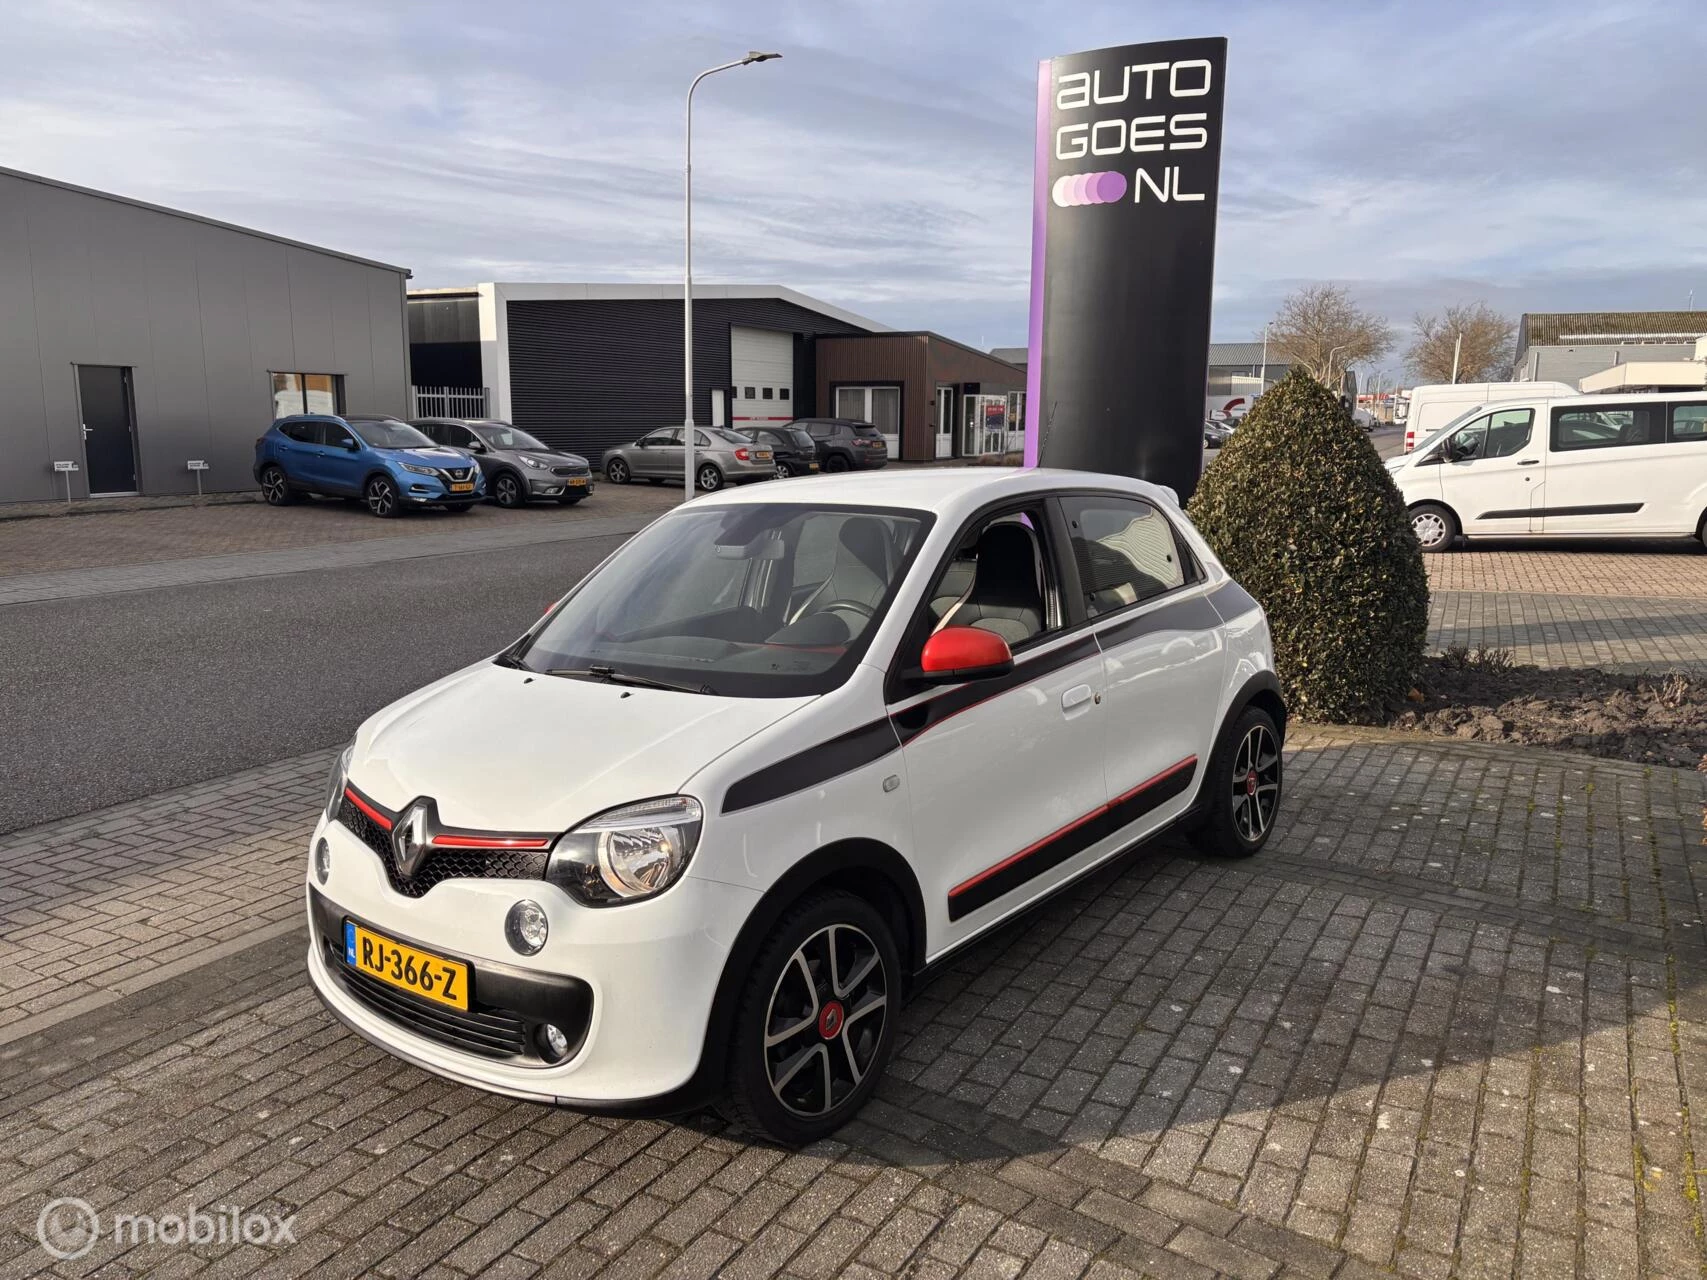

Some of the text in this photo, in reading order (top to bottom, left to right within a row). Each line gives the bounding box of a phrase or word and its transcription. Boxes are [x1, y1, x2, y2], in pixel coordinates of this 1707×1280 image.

[1056, 112, 1207, 160] GOES
[1134, 166, 1205, 203] NL
[362, 936, 457, 1001] RJ-366-Z
